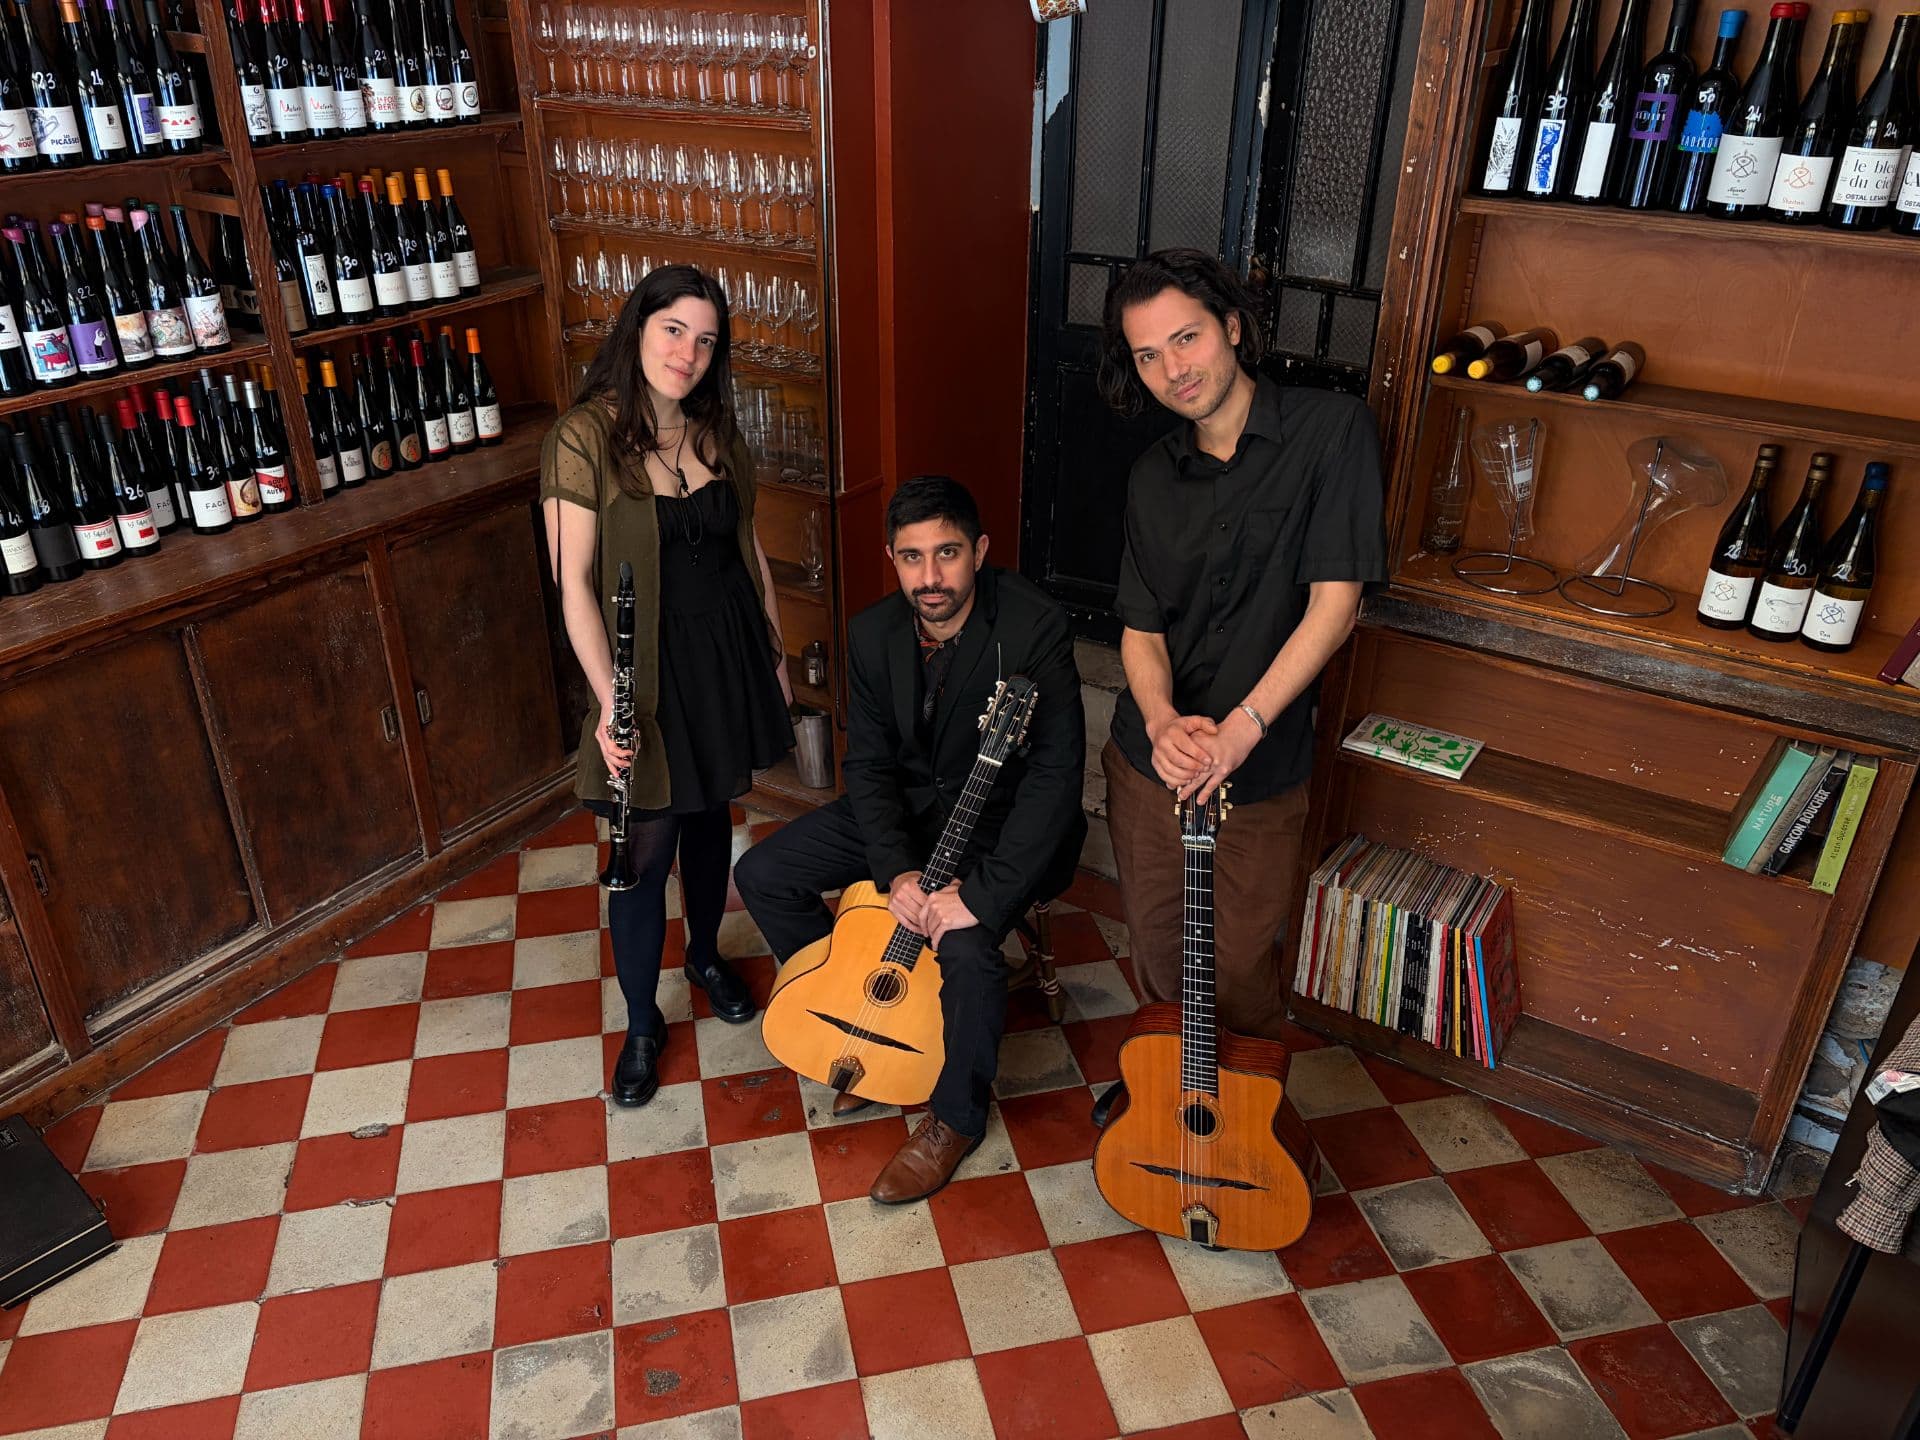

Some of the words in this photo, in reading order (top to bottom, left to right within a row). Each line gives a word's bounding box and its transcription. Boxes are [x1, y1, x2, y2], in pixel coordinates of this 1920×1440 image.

[275, 54, 289, 70] 20
[343, 66, 356, 79] 26
[36, 72, 56, 90] 23
[1545, 95, 1568, 111] 30
[1746, 105, 1762, 122] 24
[1884, 121, 1898, 138] 24
[1853, 159, 1867, 172] le
[1849, 175, 1868, 189] du
[1846, 193, 1867, 201] OSTAL
[203, 277, 217, 291] 22
[78, 285, 96, 300] 22
[125, 484, 145, 501] 26
[1787, 558, 1807, 575] 30
[1752, 794, 1780, 831] NATURE
[1779, 824, 1807, 855] GARÇON
[1800, 789, 1832, 826] BOUCHER
